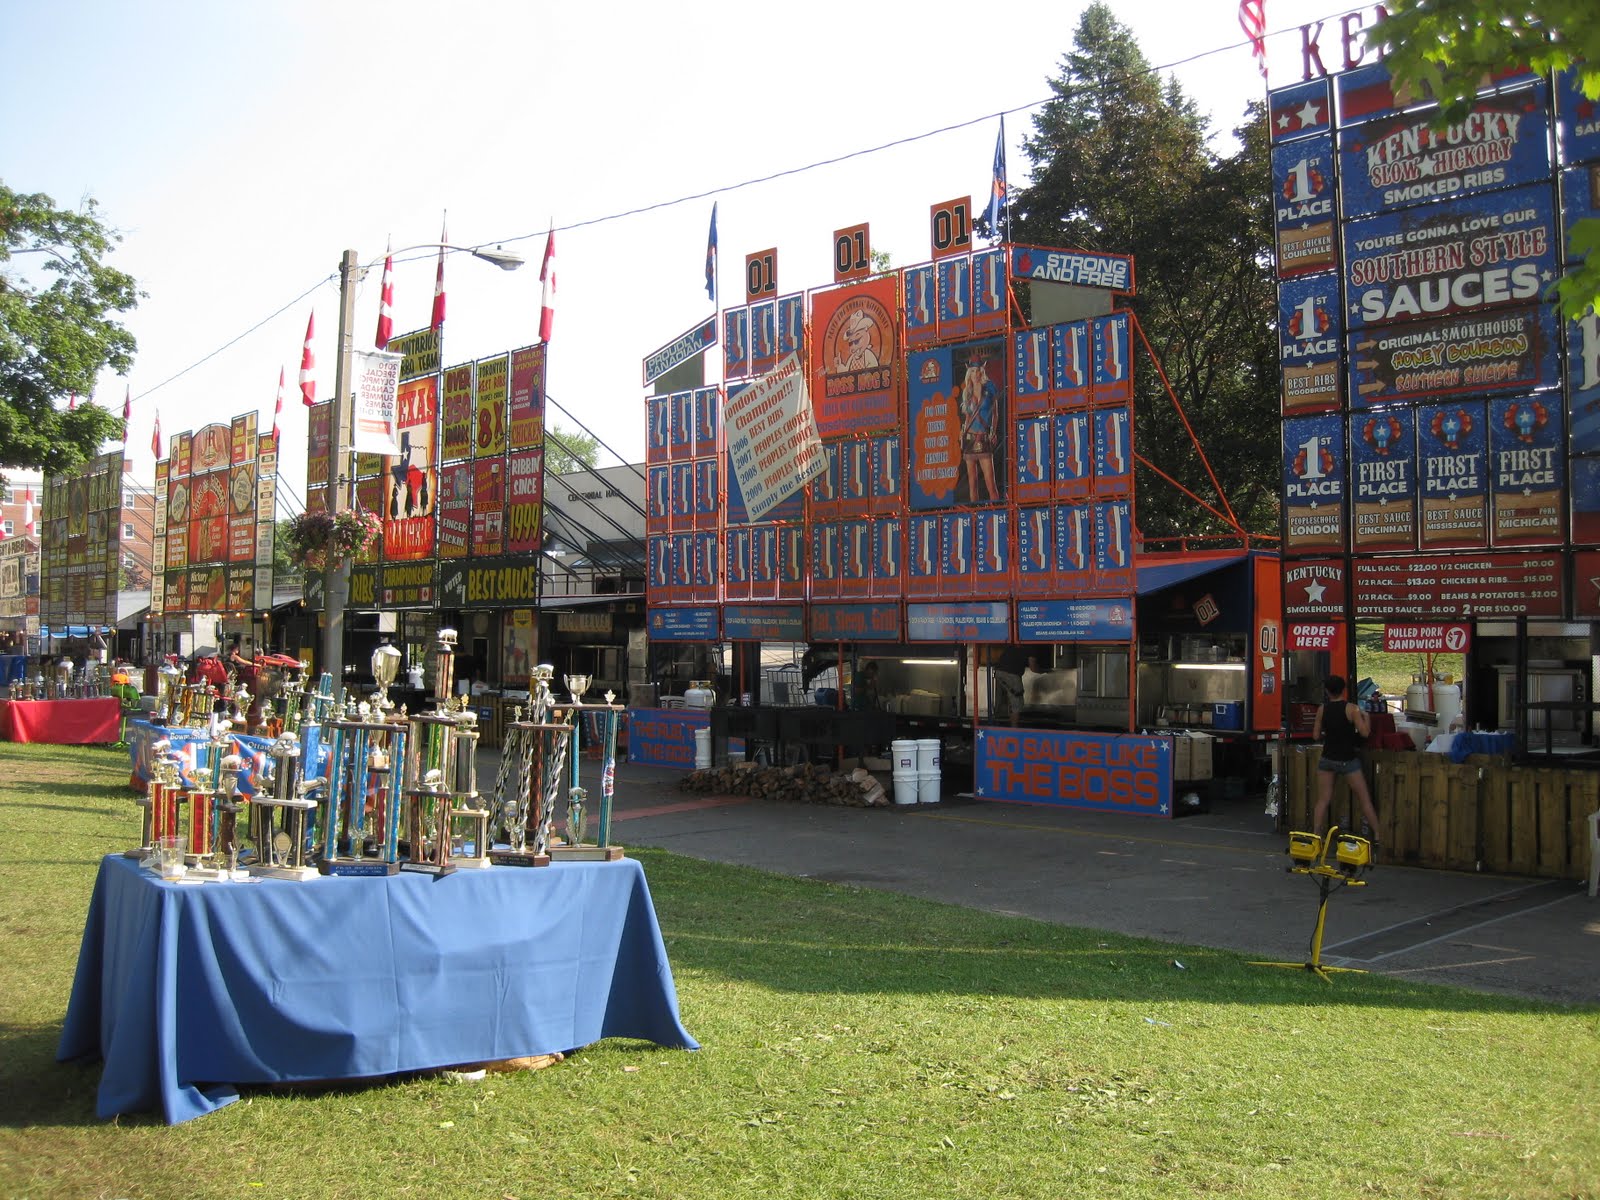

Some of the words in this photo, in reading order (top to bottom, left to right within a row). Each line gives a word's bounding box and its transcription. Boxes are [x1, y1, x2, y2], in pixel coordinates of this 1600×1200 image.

[1371, 156, 1421, 188] SLOW
[1433, 137, 1513, 176] HICKORY
[1384, 177, 1460, 205] SMOKED
[1464, 168, 1505, 189] RIBS
[1277, 200, 1332, 222] PLACE
[932, 203, 970, 251] 01
[1355, 233, 1403, 251] YOU'RE
[1406, 224, 1459, 242] GONNA
[1462, 216, 1500, 232] LOVE
[1503, 209, 1536, 224] OUR
[835, 229, 868, 274] 01
[1283, 241, 1300, 252] BEST
[1302, 236, 1331, 248] CHICKEN
[1046, 253, 1127, 275] STRONG
[1352, 241, 1464, 286] SOUTHERN
[1470, 226, 1547, 266] STYLE
[747, 255, 776, 296] 01
[1031, 265, 1074, 283] AND
[1074, 269, 1126, 289] FREE
[1361, 264, 1540, 322] SAUCES
[1378, 331, 1442, 351] ORIGINAL
[1442, 317, 1524, 341] SMOKEHOUSE
[648, 332, 697, 368] PROUDLY
[1283, 339, 1337, 358] PLACE
[1391, 342, 1445, 370] HONEY
[1447, 333, 1528, 363] BOURBON
[418, 351, 439, 371] TEAM
[646, 338, 703, 382] CANADIAN
[446, 367, 471, 393] OVER
[765, 358, 797, 391] Proud
[1288, 377, 1310, 389] BEST
[1314, 373, 1335, 386] RIBS
[1395, 367, 1459, 392] SOUTHERN
[1464, 360, 1520, 385] SUICIDE
[827, 375, 855, 397] BOSS
[1287, 386, 1336, 396] WOODBRIDGE
[731, 435, 749, 455] 2006
[748, 421, 766, 440] BEST
[767, 406, 785, 427] RIBS
[753, 429, 783, 455] PEOPLES
[783, 409, 810, 434] CHOICE
[512, 455, 541, 476] RIBBIN'
[739, 465, 758, 485] 2008
[758, 445, 788, 472] PEOPLES
[787, 424, 814, 449] CHOICE
[1500, 447, 1556, 472] FIRST
[745, 482, 763, 502] 2009
[763, 462, 794, 490] PEOPLES
[793, 442, 820, 467] CHOICE
[1359, 458, 1409, 483] FIRST
[1426, 454, 1480, 478] FIRST
[513, 478, 537, 495] SINCE
[779, 479, 794, 494] the
[1286, 481, 1340, 497] PLACE
[1359, 481, 1407, 496] PLACE
[1426, 476, 1478, 491] PLACE
[1500, 470, 1555, 486] PLACE
[511, 502, 540, 542] 1999
[1358, 514, 1380, 525] BEST
[1384, 511, 1411, 523] SAUCE
[1426, 521, 1483, 530] MISSISSAUGA
[1427, 509, 1449, 521] BEST
[1454, 508, 1483, 519] SAUCE
[1499, 518, 1558, 528] MICHIGAN
[1290, 525, 1339, 536] LONDON
[1358, 525, 1411, 535] CINCINNATI
[1286, 565, 1342, 584] KENTUCKY
[1408, 563, 1437, 572] $22.00
[1454, 562, 1492, 570] CHICKEN
[1523, 560, 1555, 568] $10.00
[352, 574, 374, 603] RIBS
[468, 568, 496, 601] BEST
[496, 566, 535, 600] SAUCE
[1407, 578, 1436, 587] $13.00
[1441, 577, 1478, 585] CHICKEN
[1523, 575, 1553, 583] $15.00
[1407, 593, 1432, 601] $9.00
[1471, 592, 1478, 600] &
[1531, 590, 1558, 598] $2.00
[1286, 605, 1344, 614] SMOKEHOUSE
[1431, 606, 1457, 614] $6.00
[1462, 604, 1471, 615] 2
[1494, 605, 1527, 613] $10.00
[1260, 625, 1278, 654] 01
[1293, 625, 1335, 636] ORDER
[1388, 628, 1418, 638] PULLED
[1420, 626, 1443, 637] PORK
[1296, 637, 1329, 647] HERE
[1388, 638, 1442, 650] SANDWICH
[986, 736, 1020, 759] NO
[1023, 738, 1105, 765] SAUCE
[1106, 744, 1158, 769] LIKE
[986, 760, 1052, 796] THE
[1059, 766, 1159, 806] BOSS
